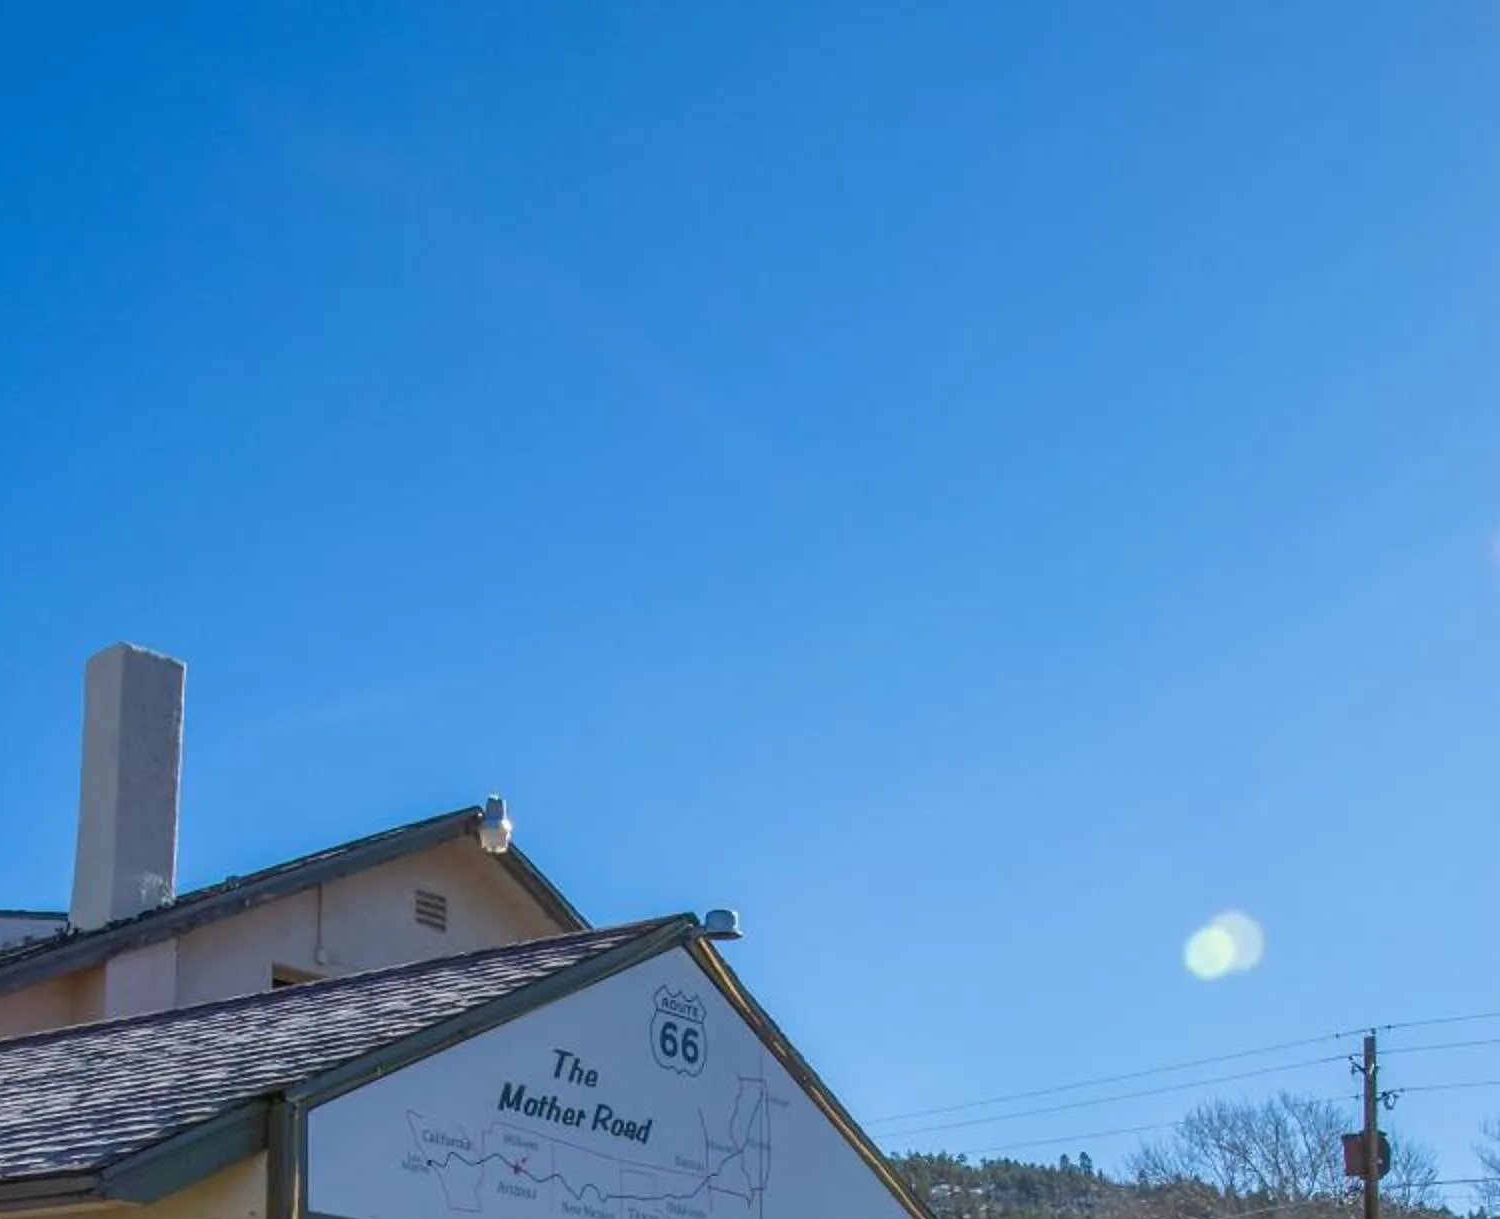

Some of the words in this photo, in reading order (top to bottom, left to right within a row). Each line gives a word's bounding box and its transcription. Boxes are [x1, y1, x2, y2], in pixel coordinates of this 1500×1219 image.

[661, 996, 699, 1019] ROUTE
[660, 1021, 699, 1064] 66
[553, 1048, 599, 1088] The
[498, 1081, 586, 1128] Mother
[592, 1103, 653, 1145] Road
